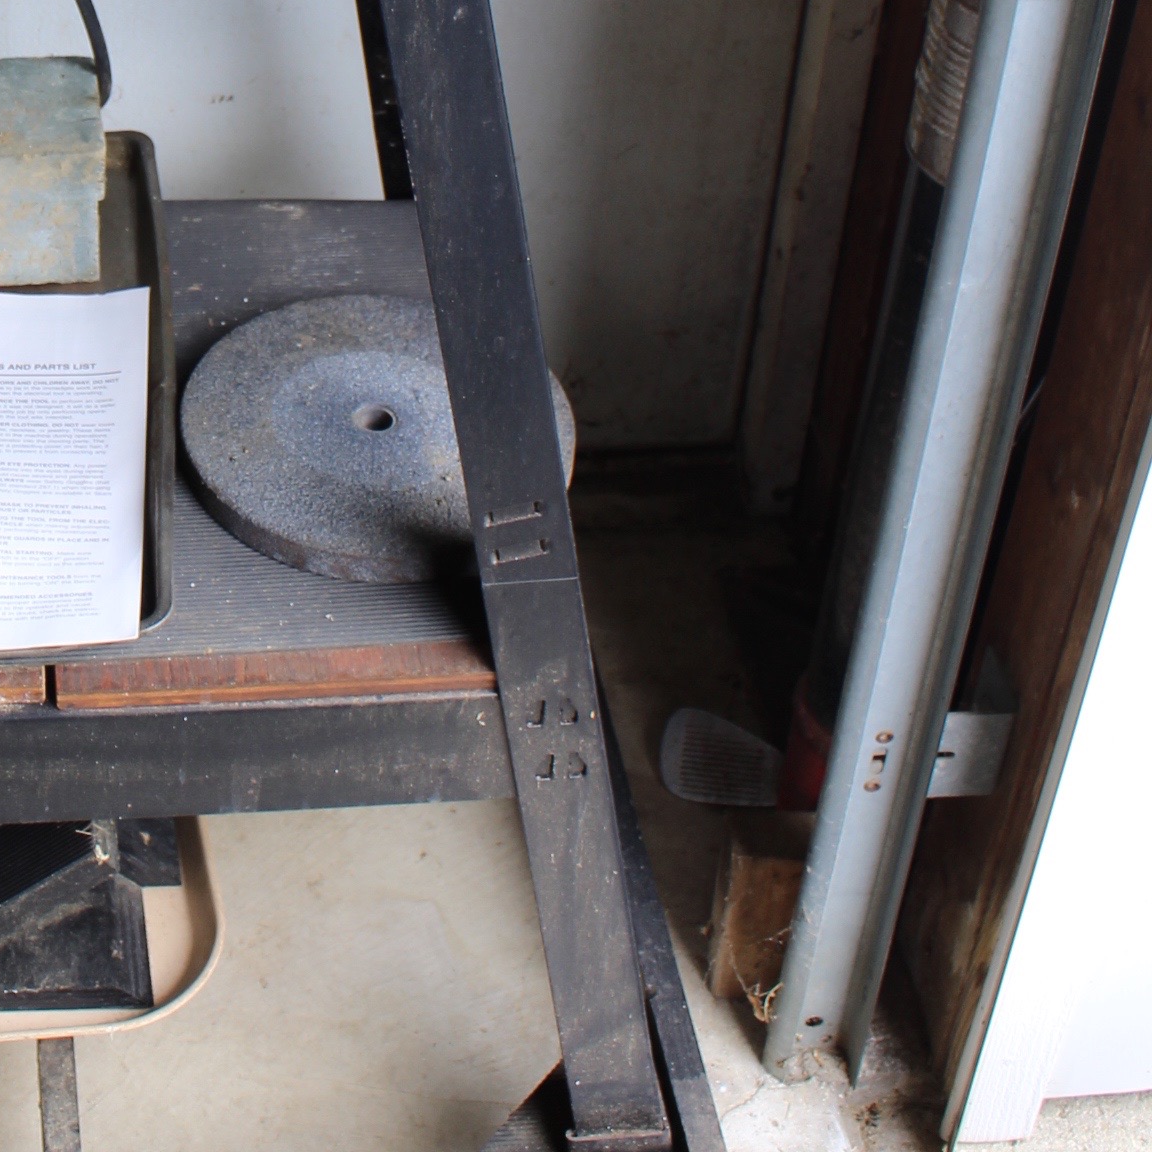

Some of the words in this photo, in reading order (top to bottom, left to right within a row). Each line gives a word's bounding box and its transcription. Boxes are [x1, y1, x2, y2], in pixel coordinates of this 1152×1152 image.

[8, 362, 32, 371] AND
[34, 363, 70, 371] PARTS
[73, 362, 98, 371] LIST
